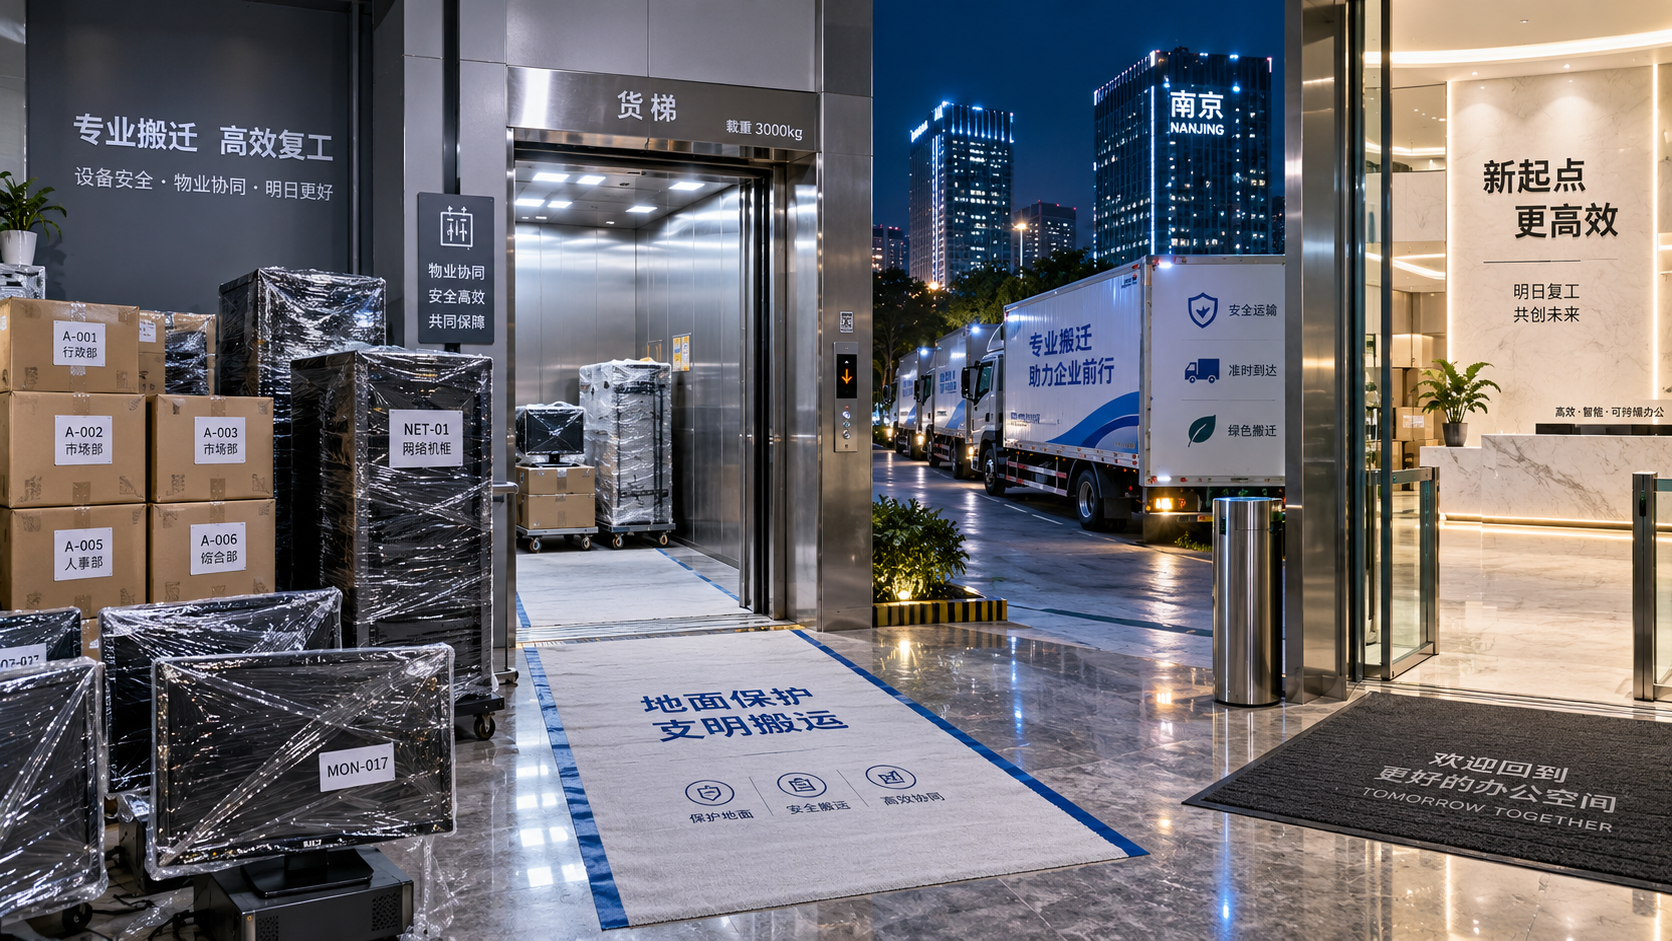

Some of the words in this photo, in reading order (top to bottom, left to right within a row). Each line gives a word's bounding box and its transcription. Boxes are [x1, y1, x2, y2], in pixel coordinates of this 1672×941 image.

[617, 90, 677, 122] 货梯
[1170, 90, 1224, 120] 南京
[74, 114, 197, 151] 专业搬迁
[220, 125, 332, 160] 高效复工
[727, 120, 752, 134] 载重
[756, 123, 802, 140] 3000kg
[1170, 121, 1225, 136] NANJING
[1484, 158, 1585, 194] 新起点
[1515, 203, 1618, 238] 更高效
[429, 263, 484, 280] 物业协同
[429, 288, 485, 304] 安全高效
[1514, 283, 1579, 299] 明日复工
[1230, 304, 1277, 316] 安全运输
[1514, 306, 1579, 322] 共创未来
[63, 331, 96, 342] A-001
[1029, 323, 1093, 357] 专业搬迁
[1028, 357, 1115, 388] 助力企业前行
[1229, 364, 1276, 376] 准时到达
[65, 427, 102, 437] A-002
[204, 428, 237, 438] A-003
[405, 423, 448, 435] NET-01
[65, 539, 102, 552] A-005
[201, 534, 237, 546] A-006
[65, 556, 103, 570] 人事部
[640, 687, 813, 713] 地面保护
[328, 757, 388, 777] MON-017
[1428, 752, 1569, 783] 欢迎回到
[1373, 765, 1617, 813] 更好的办公空间
[1363, 787, 1486, 812] TOMORROW
[1494, 806, 1613, 833] TOGETHER
